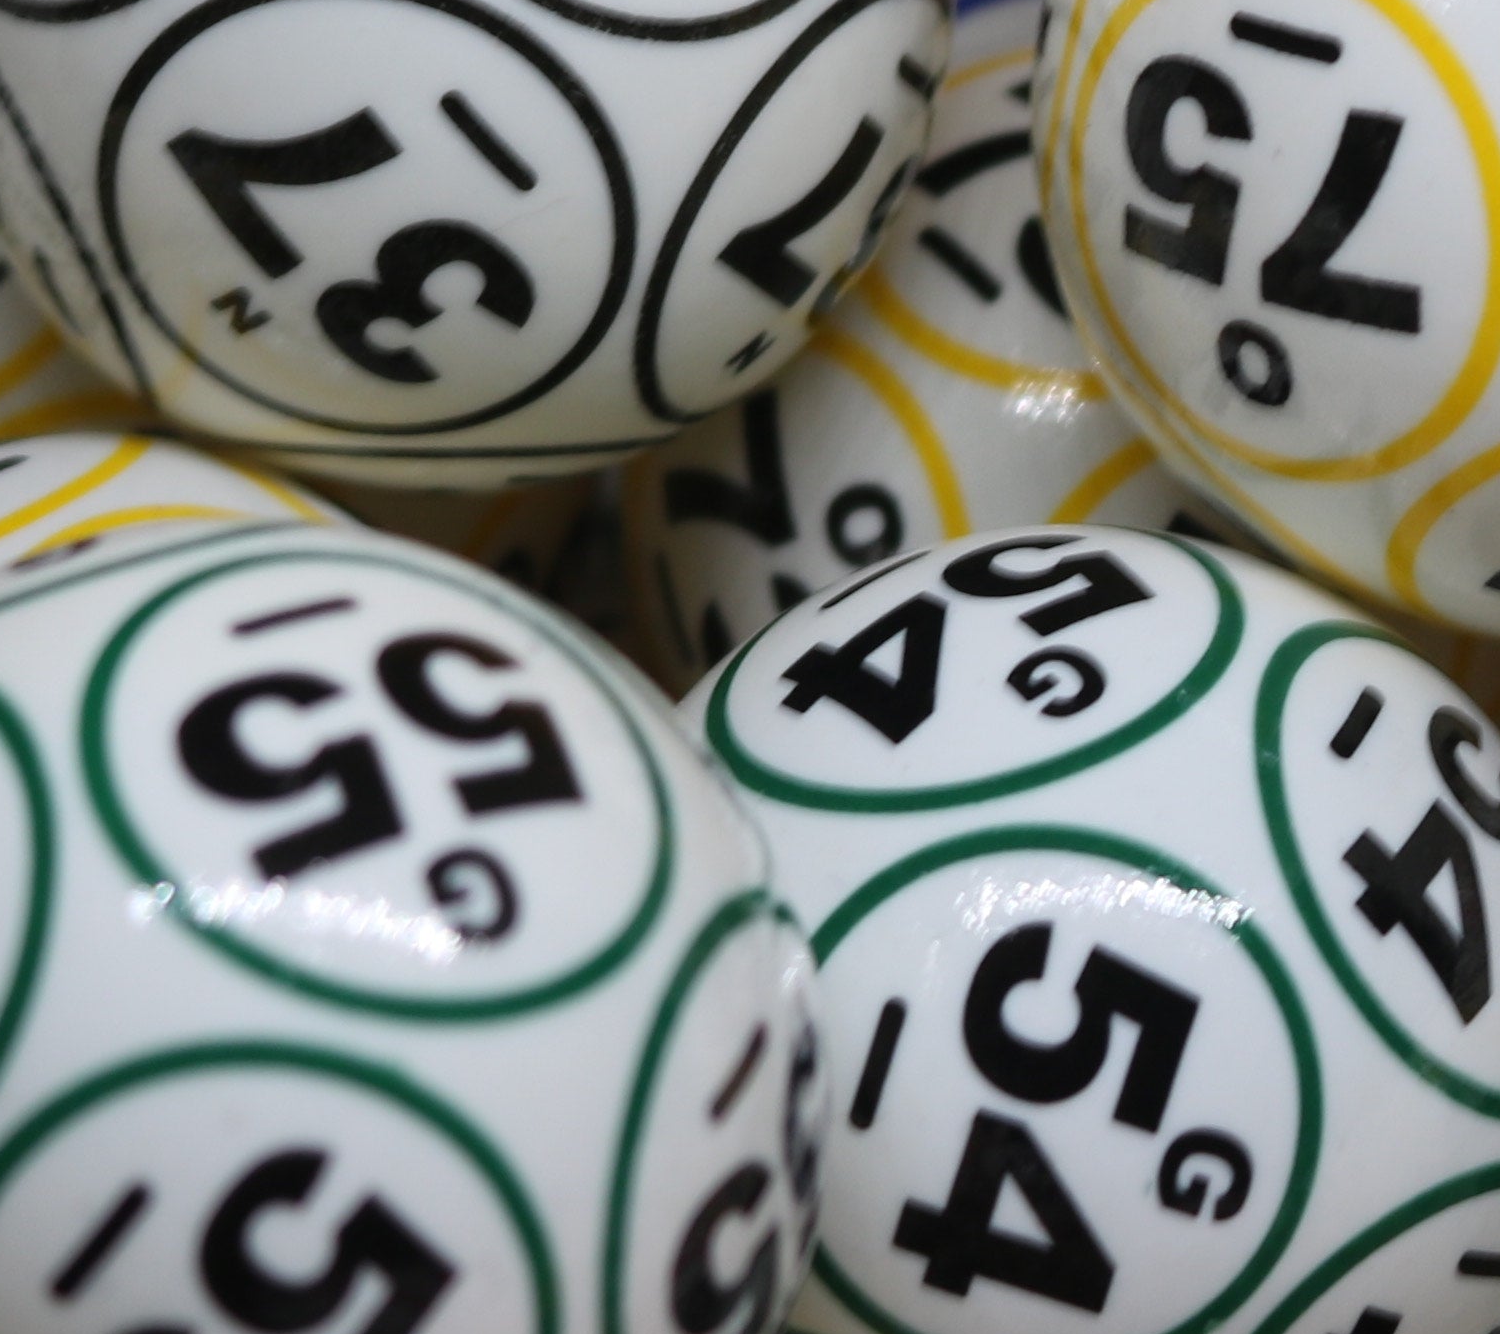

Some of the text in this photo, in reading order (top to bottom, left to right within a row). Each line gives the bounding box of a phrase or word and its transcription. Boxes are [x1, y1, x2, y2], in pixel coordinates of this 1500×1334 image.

[165, 105, 537, 386] 37
[1122, 52, 1424, 337] 75
[211, 285, 272, 337] N
[1216, 318, 1295, 410] O
[778, 534, 1160, 746] 54
[1005, 643, 1108, 719] G
[175, 632, 586, 876] 55
[424, 845, 523, 944] G
[892, 919, 1202, 1316] 54
[1156, 1126, 1255, 1225] G
